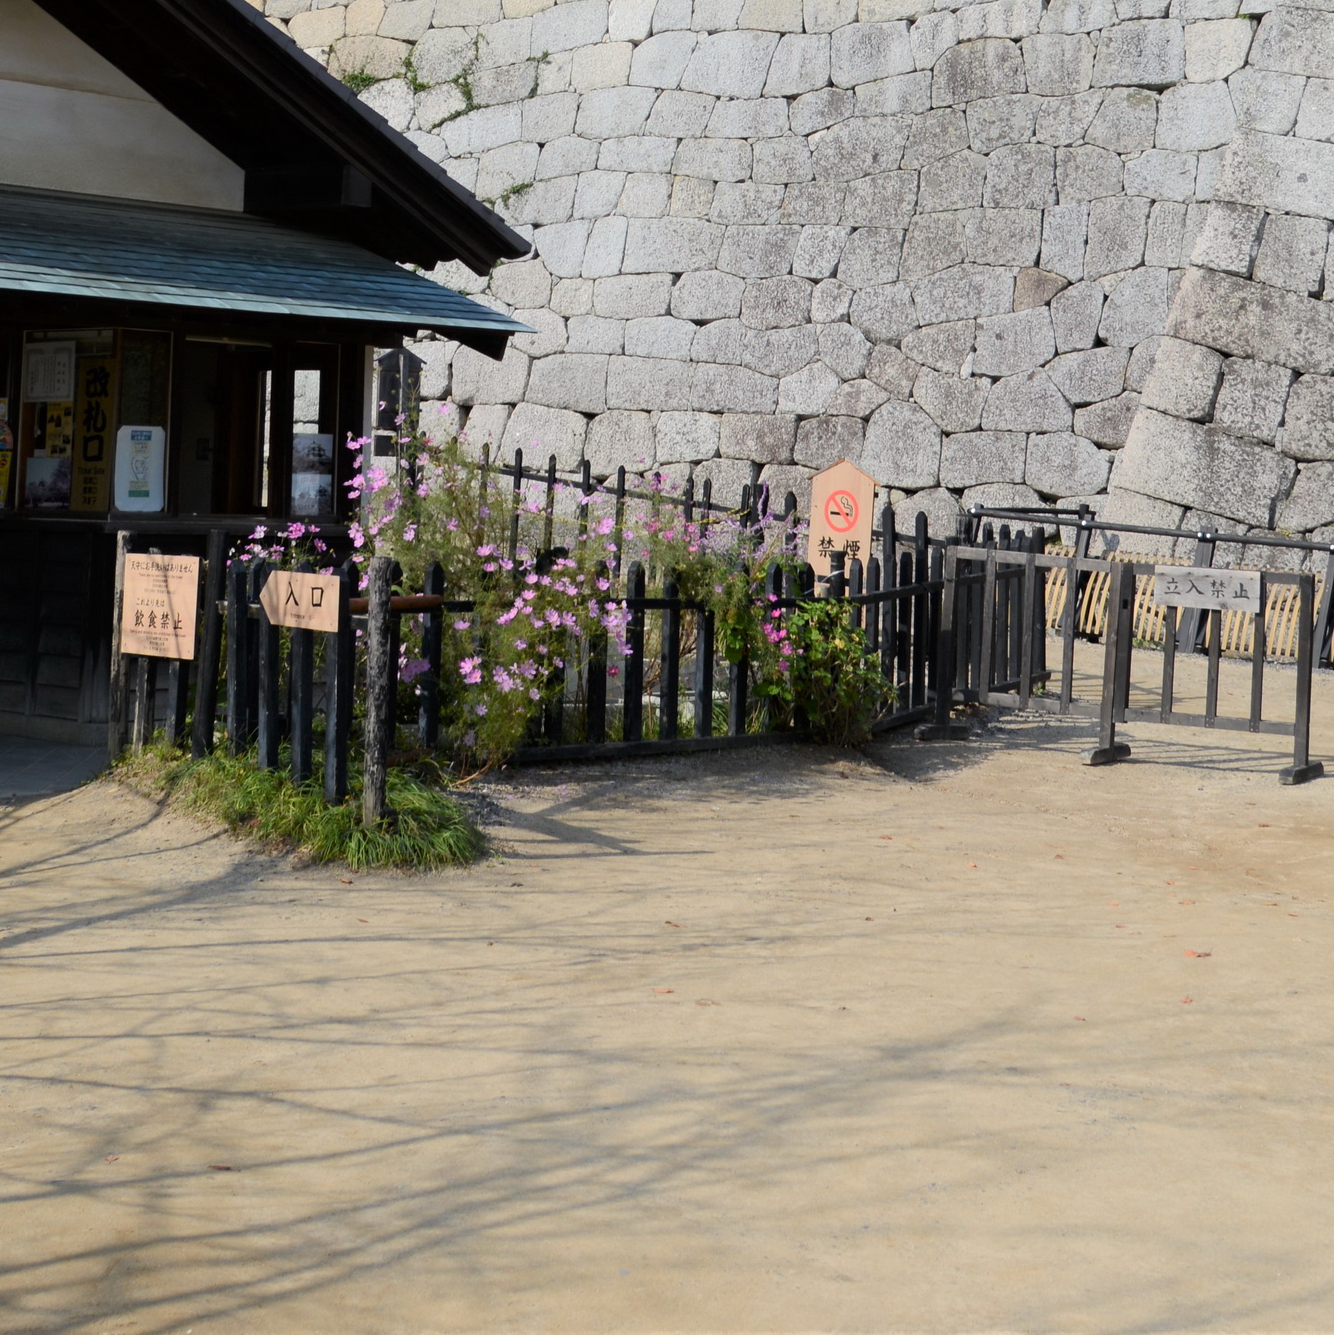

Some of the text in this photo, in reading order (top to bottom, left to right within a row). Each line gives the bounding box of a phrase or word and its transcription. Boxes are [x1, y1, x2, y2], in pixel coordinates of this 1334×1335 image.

[82, 366, 110, 462] 改札口
[818, 535, 861, 560] 禁煙
[285, 580, 325, 608] 入口
[1163, 576, 1251, 600] 立入禁止
[136, 597, 166, 608] これより先は
[133, 608, 183, 631] 飲食禁止
